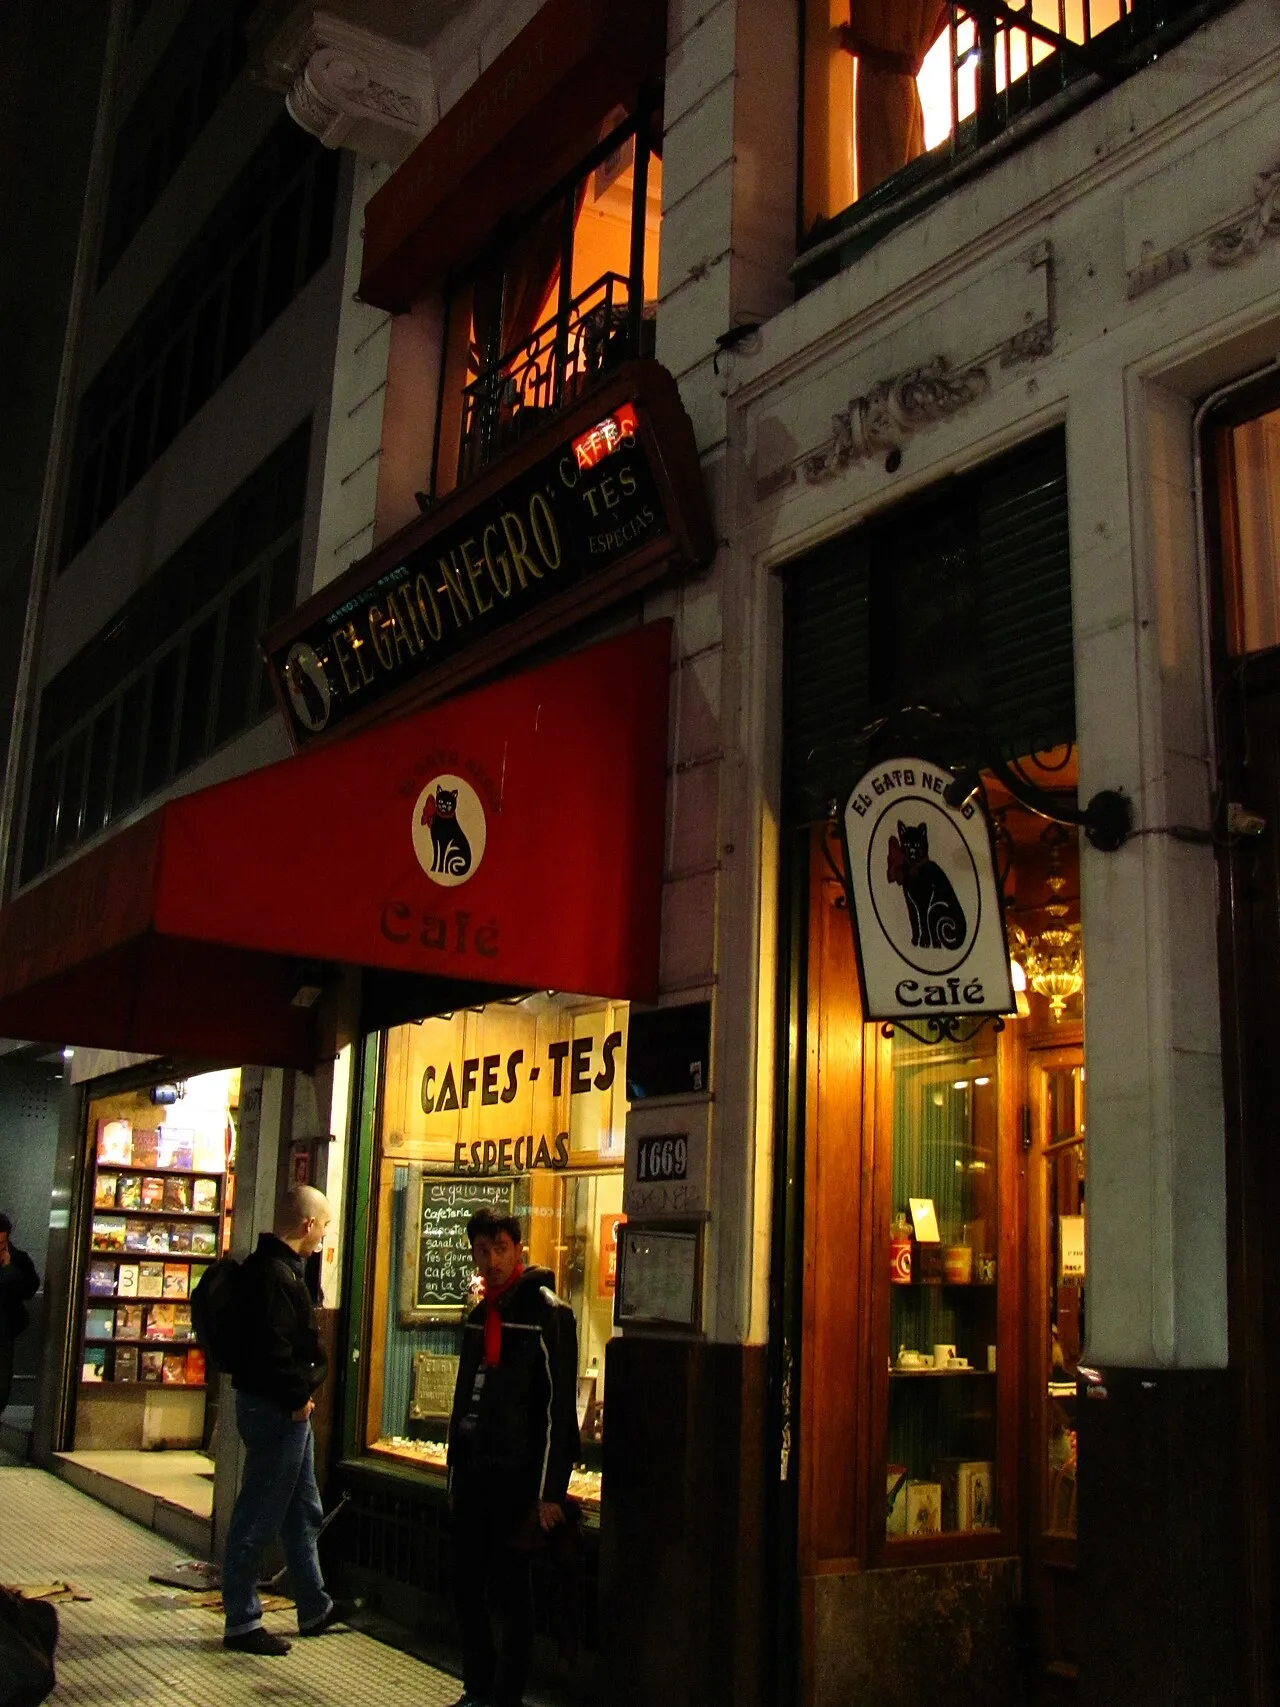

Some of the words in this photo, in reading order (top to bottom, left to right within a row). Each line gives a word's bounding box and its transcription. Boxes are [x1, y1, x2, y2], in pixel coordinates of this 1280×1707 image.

[588, 503, 655, 554] ESPECIAS
[851, 794, 873, 817] EL
[871, 769, 915, 796] GATO
[922, 771, 976, 820] NEO
[380, 900, 500, 959] Café
[894, 977, 985, 1008] Café
[453, 1132, 569, 1175] ESPECIAS
[638, 1137, 687, 1179] 1669
